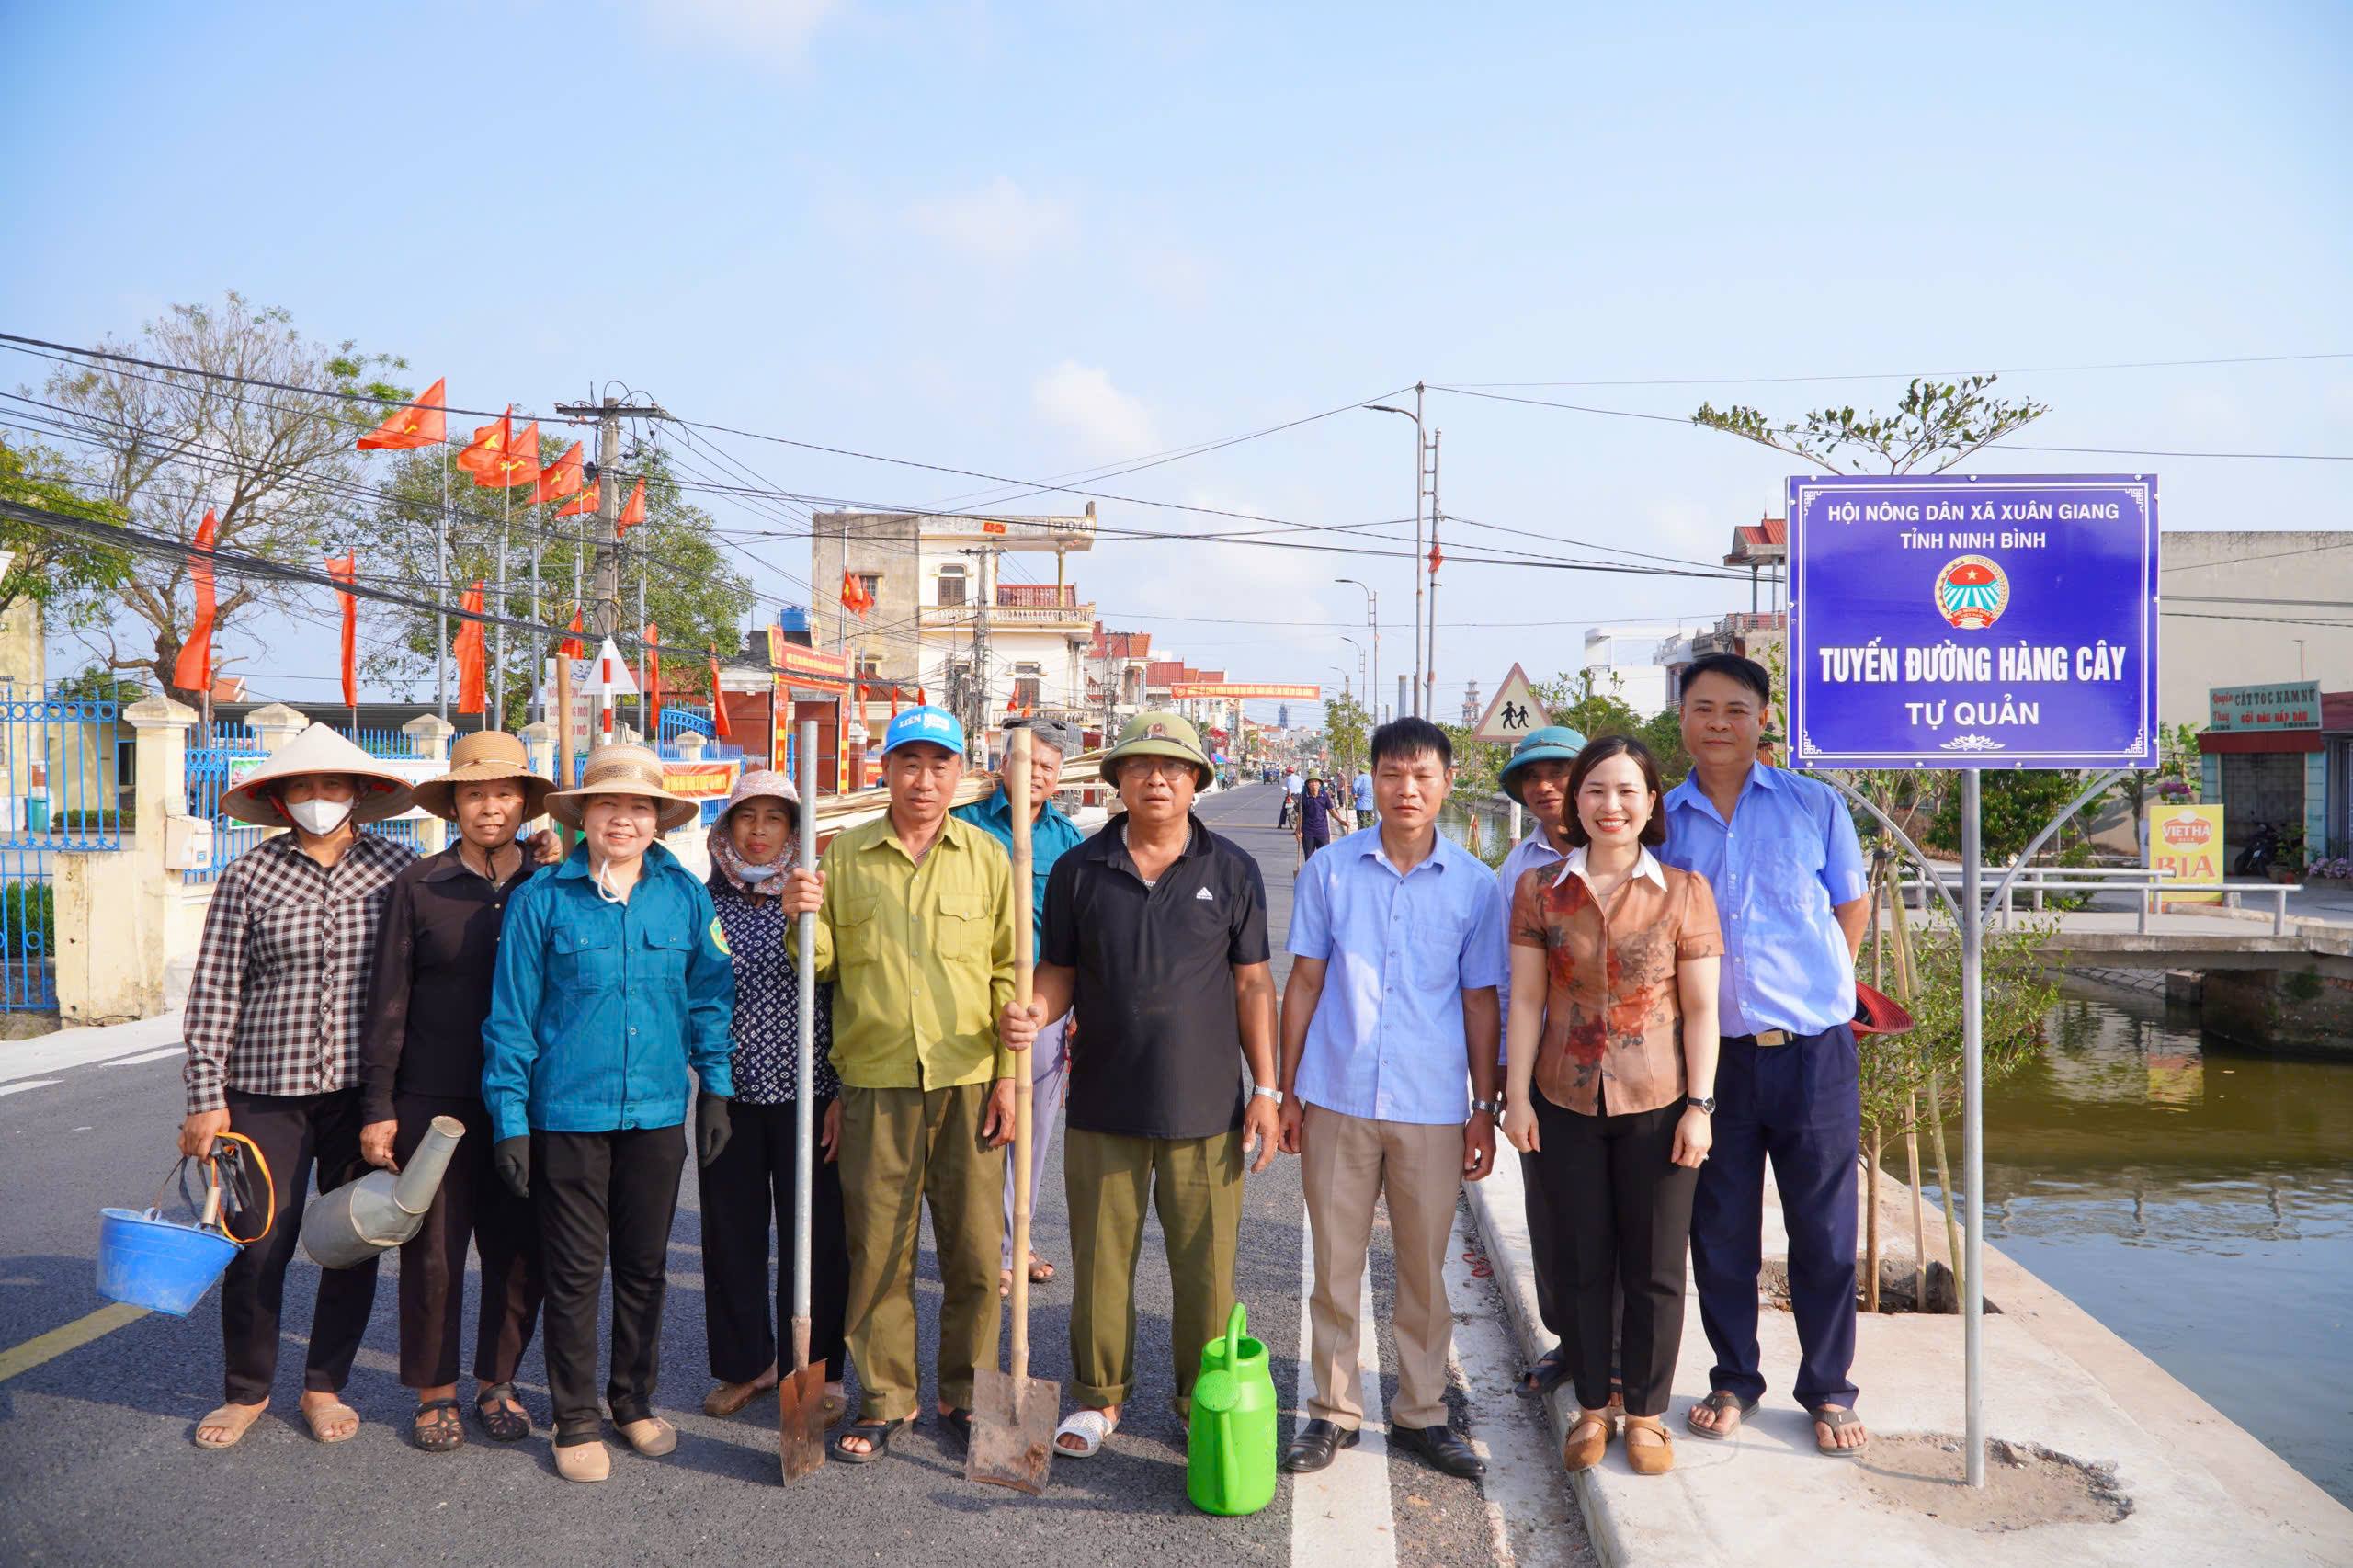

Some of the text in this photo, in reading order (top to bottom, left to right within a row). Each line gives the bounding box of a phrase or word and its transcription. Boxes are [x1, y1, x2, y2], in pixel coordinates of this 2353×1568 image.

[1828, 499, 2120, 525] HỘI NÔNG DÂN XÃ XUÂN GIANG
[1901, 527, 2046, 549] TỈNH NINH BÌNH
[1819, 636, 2127, 682] TUYẾN ĐƯỜNG HÀNG CÂY
[2276, 689, 2298, 704] NAM
[1905, 694, 2040, 731] TỰ QUẢN
[2156, 855, 2216, 879] BIA
